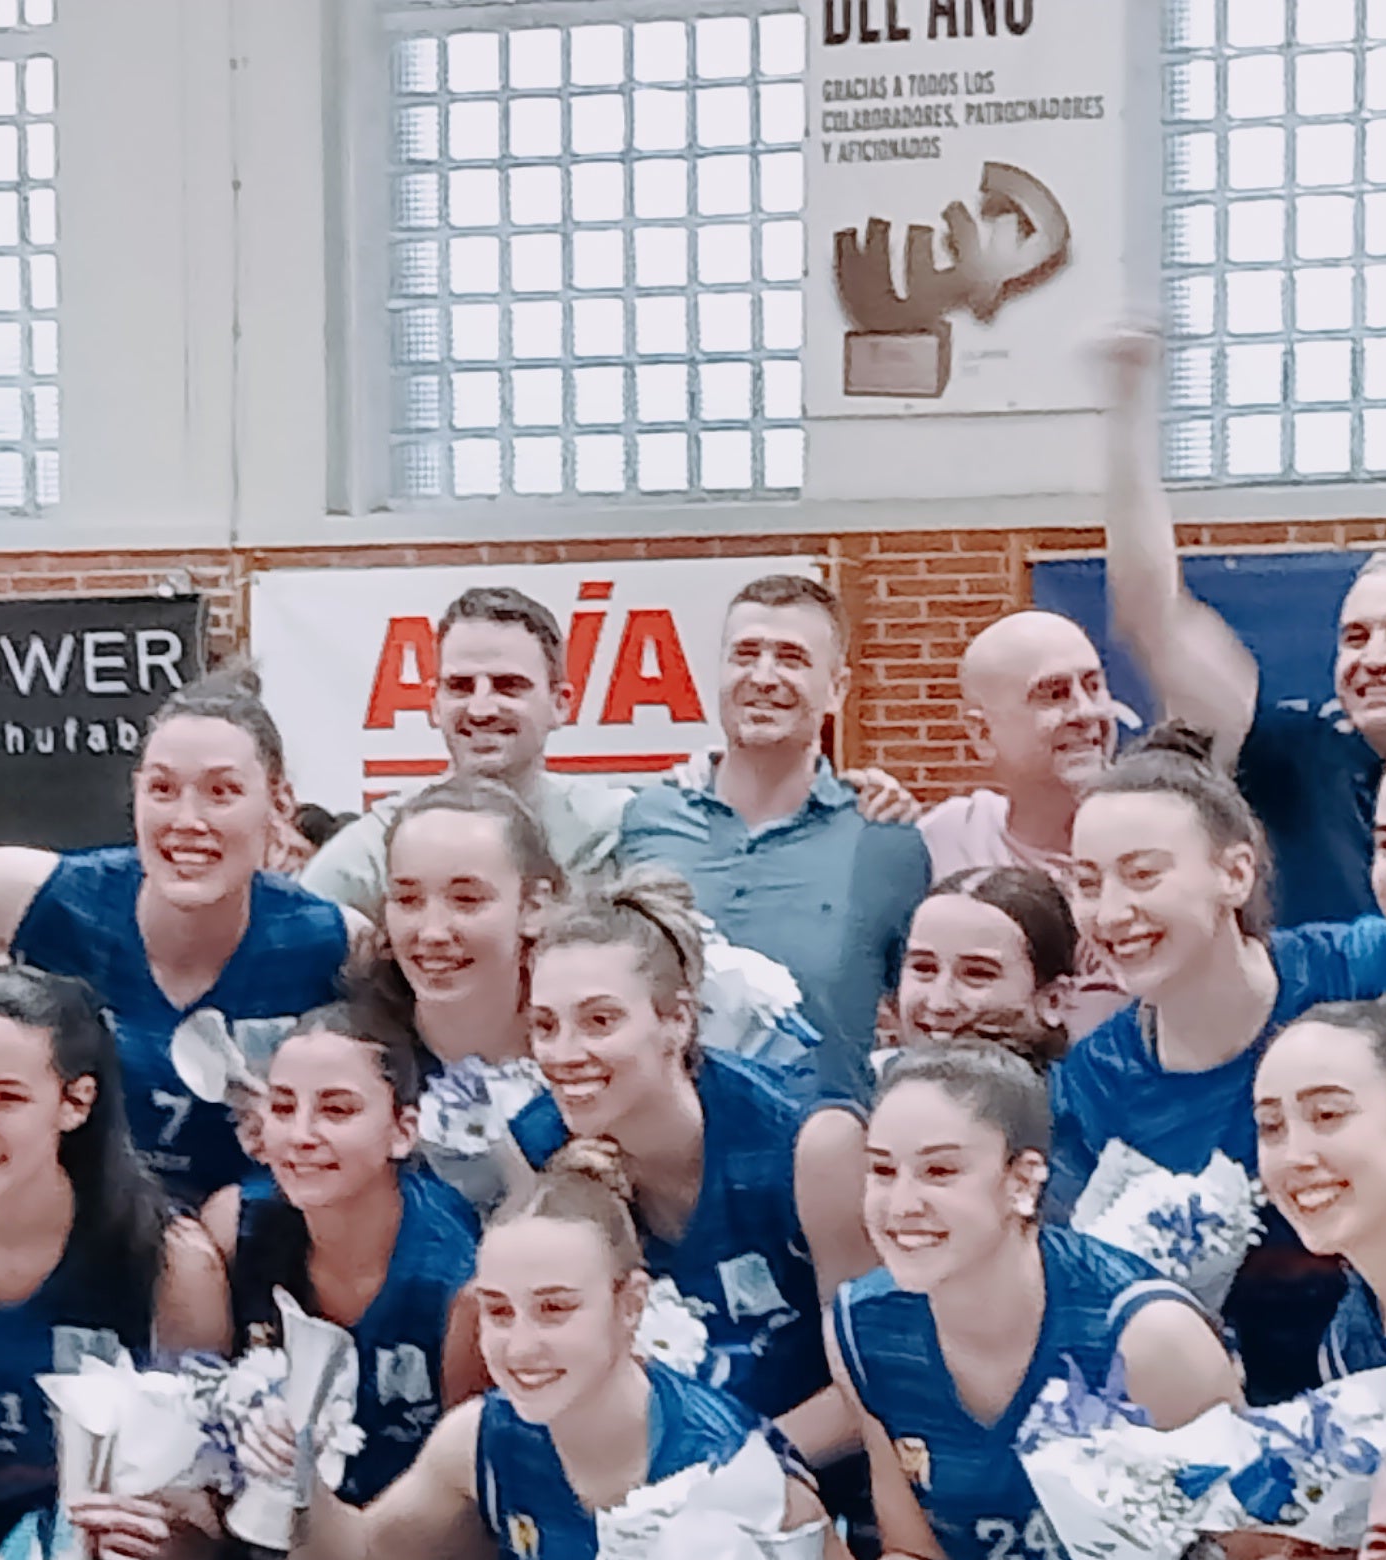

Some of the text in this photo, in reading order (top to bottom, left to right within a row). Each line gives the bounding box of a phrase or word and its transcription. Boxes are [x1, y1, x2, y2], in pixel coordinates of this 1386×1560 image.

[822, 70, 995, 102] GRACIAS A TODOS LOS
[965, 96, 1105, 125] PATROCINADORES
[822, 136, 941, 163] Y AFICIONADOS
[151, 1089, 192, 1146] 7
